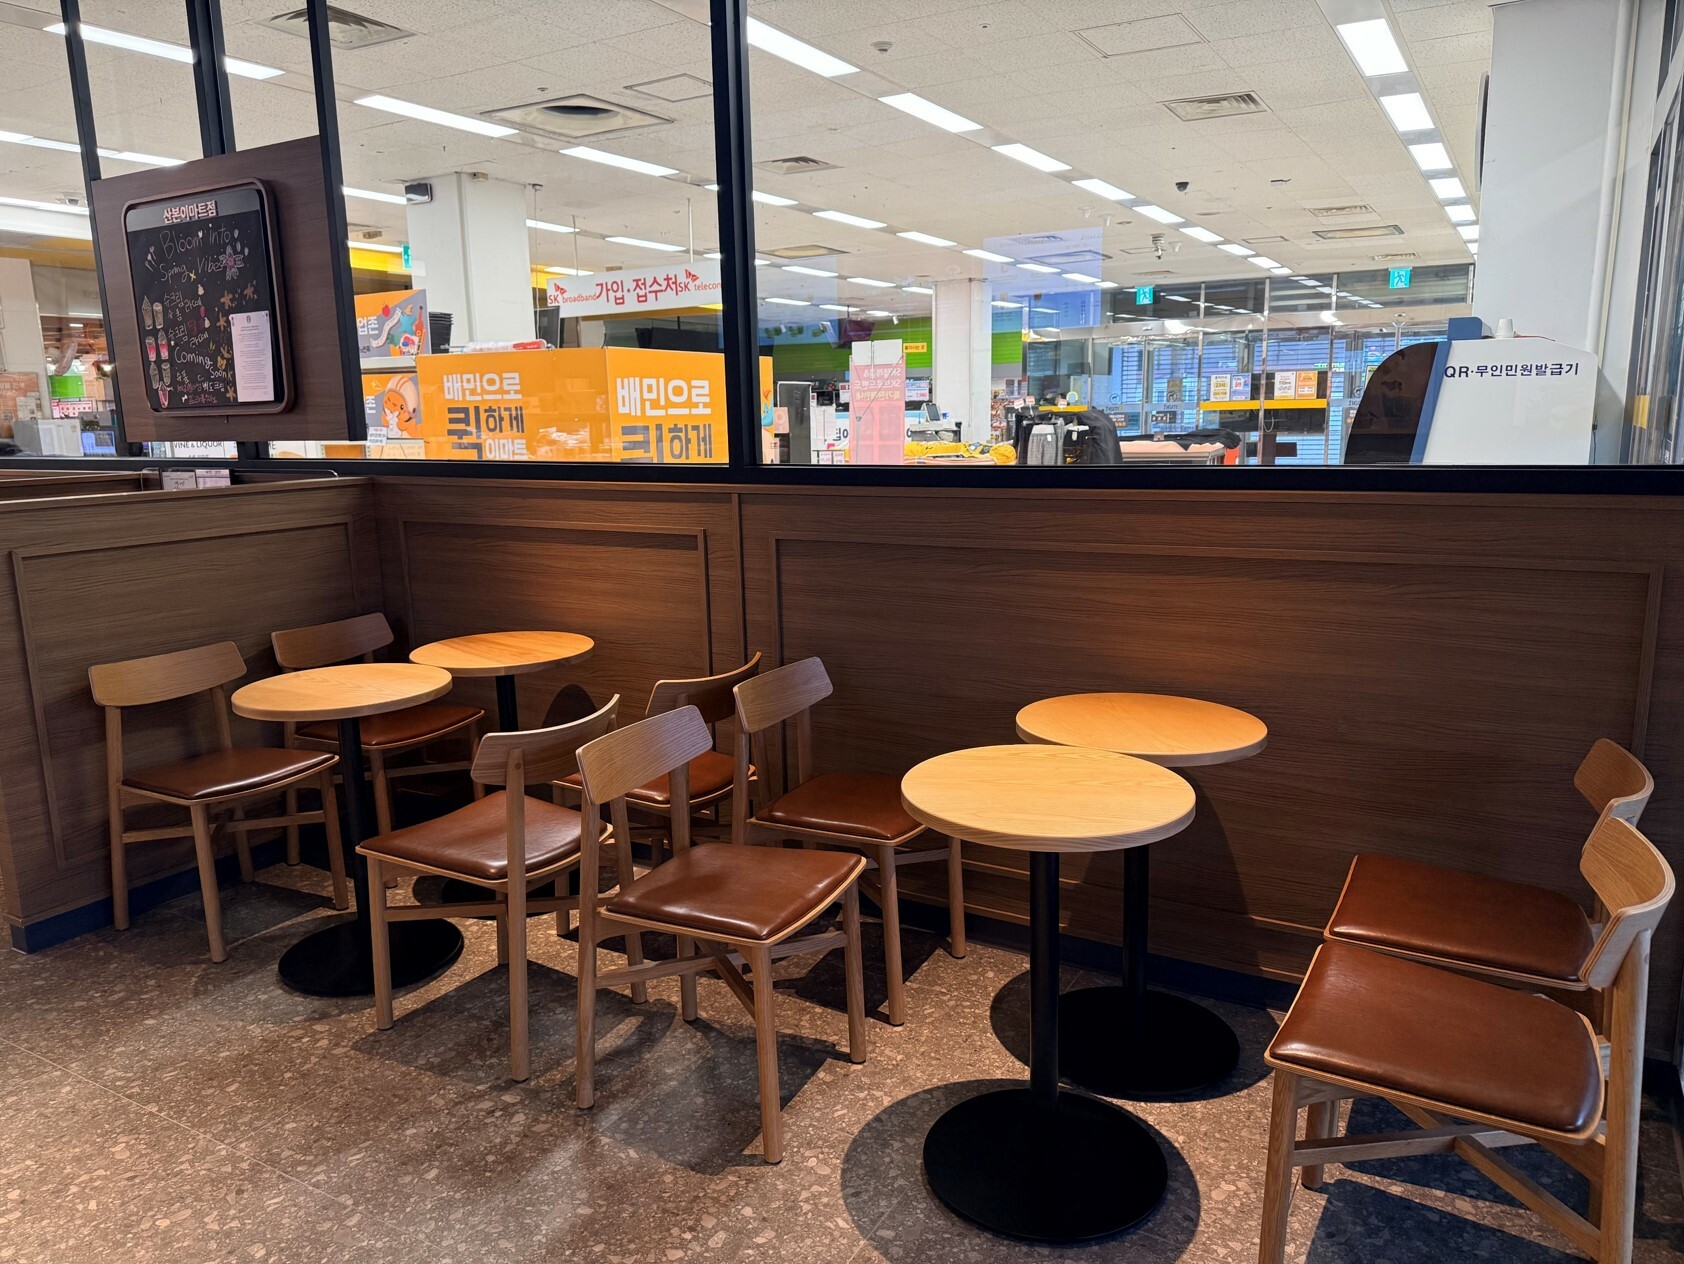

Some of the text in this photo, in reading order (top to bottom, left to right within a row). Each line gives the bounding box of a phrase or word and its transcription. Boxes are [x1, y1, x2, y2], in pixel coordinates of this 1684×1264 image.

[163, 200, 217, 224] 산본이마트점
[160, 230, 203, 259] Bloom
[160, 263, 190, 284] Spring
[548, 293, 597, 305] SK broadband
[678, 281, 691, 293] SK
[175, 347, 227, 379] Coming Soon
[443, 372, 523, 401] 배민으로
[616, 377, 711, 416] 배민으로
